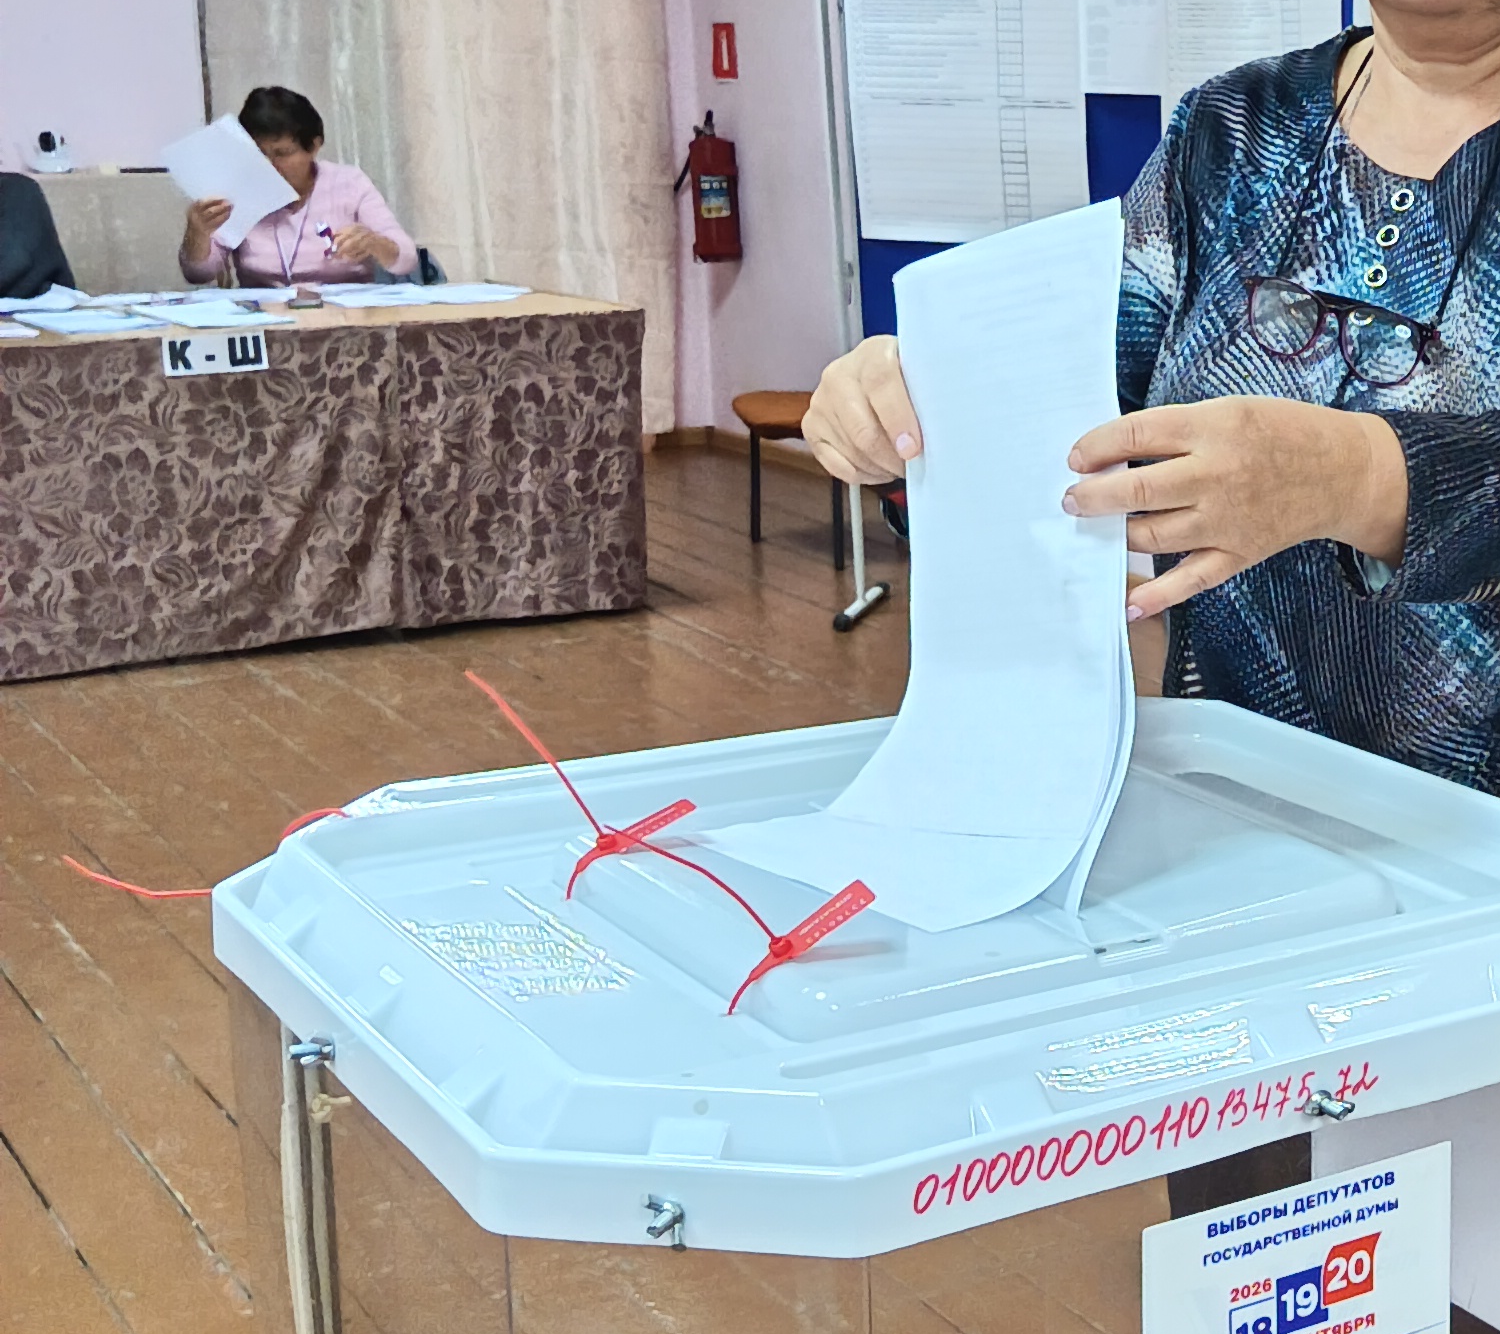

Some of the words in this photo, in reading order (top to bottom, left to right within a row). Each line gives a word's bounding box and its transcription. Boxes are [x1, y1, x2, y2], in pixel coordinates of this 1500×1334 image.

[168, 339, 192, 370] К
[227, 335, 263, 367] Ш
[1203, 1208, 1352, 1267] ГОСУДАРСТВЕННОЙ
[1355, 1198, 1399, 1224] ДУМЫ
[1207, 1202, 1288, 1239] ВЫБОРЫ
[1292, 1171, 1396, 1216] ДЕПУТАТОВ
[1229, 1277, 1273, 1304] 2026
[1280, 1282, 1319, 1323] 19
[1326, 1248, 1372, 1294] 20
